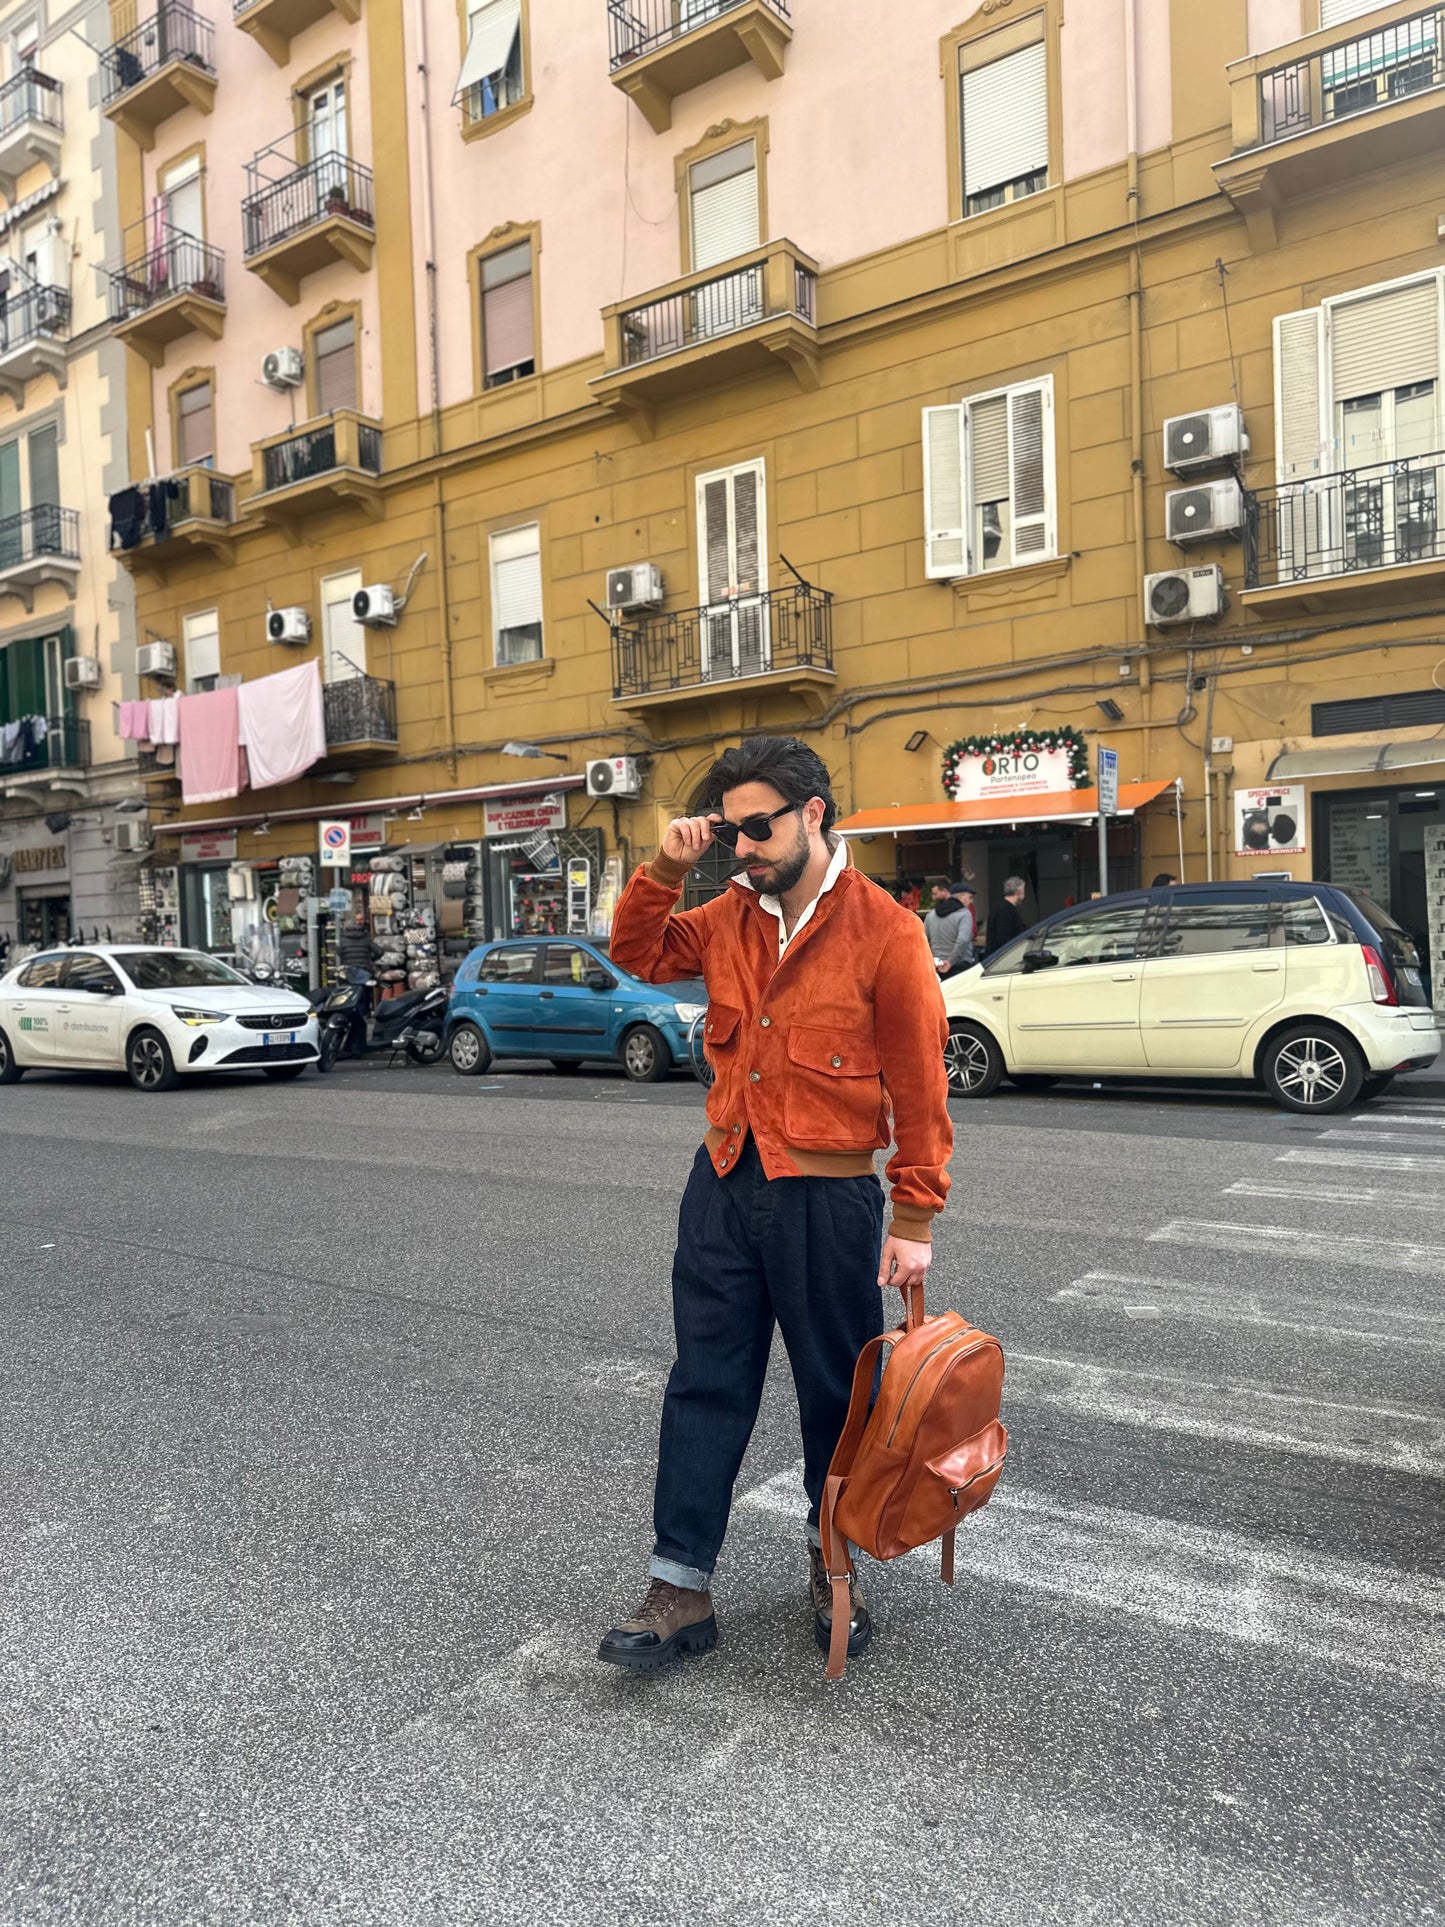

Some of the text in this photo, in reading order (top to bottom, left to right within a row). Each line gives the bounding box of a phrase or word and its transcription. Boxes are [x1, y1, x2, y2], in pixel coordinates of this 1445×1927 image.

[982, 754, 1039, 776] ORTO
[990, 773, 1037, 784] Partenopeo
[1248, 788, 1290, 798] SPECIAL PRICE
[487, 806, 561, 822] DUPLICAZIONE CHIAVI
[498, 817, 551, 830] E TELECOMANDI
[1237, 849, 1270, 857] EFFETTO
